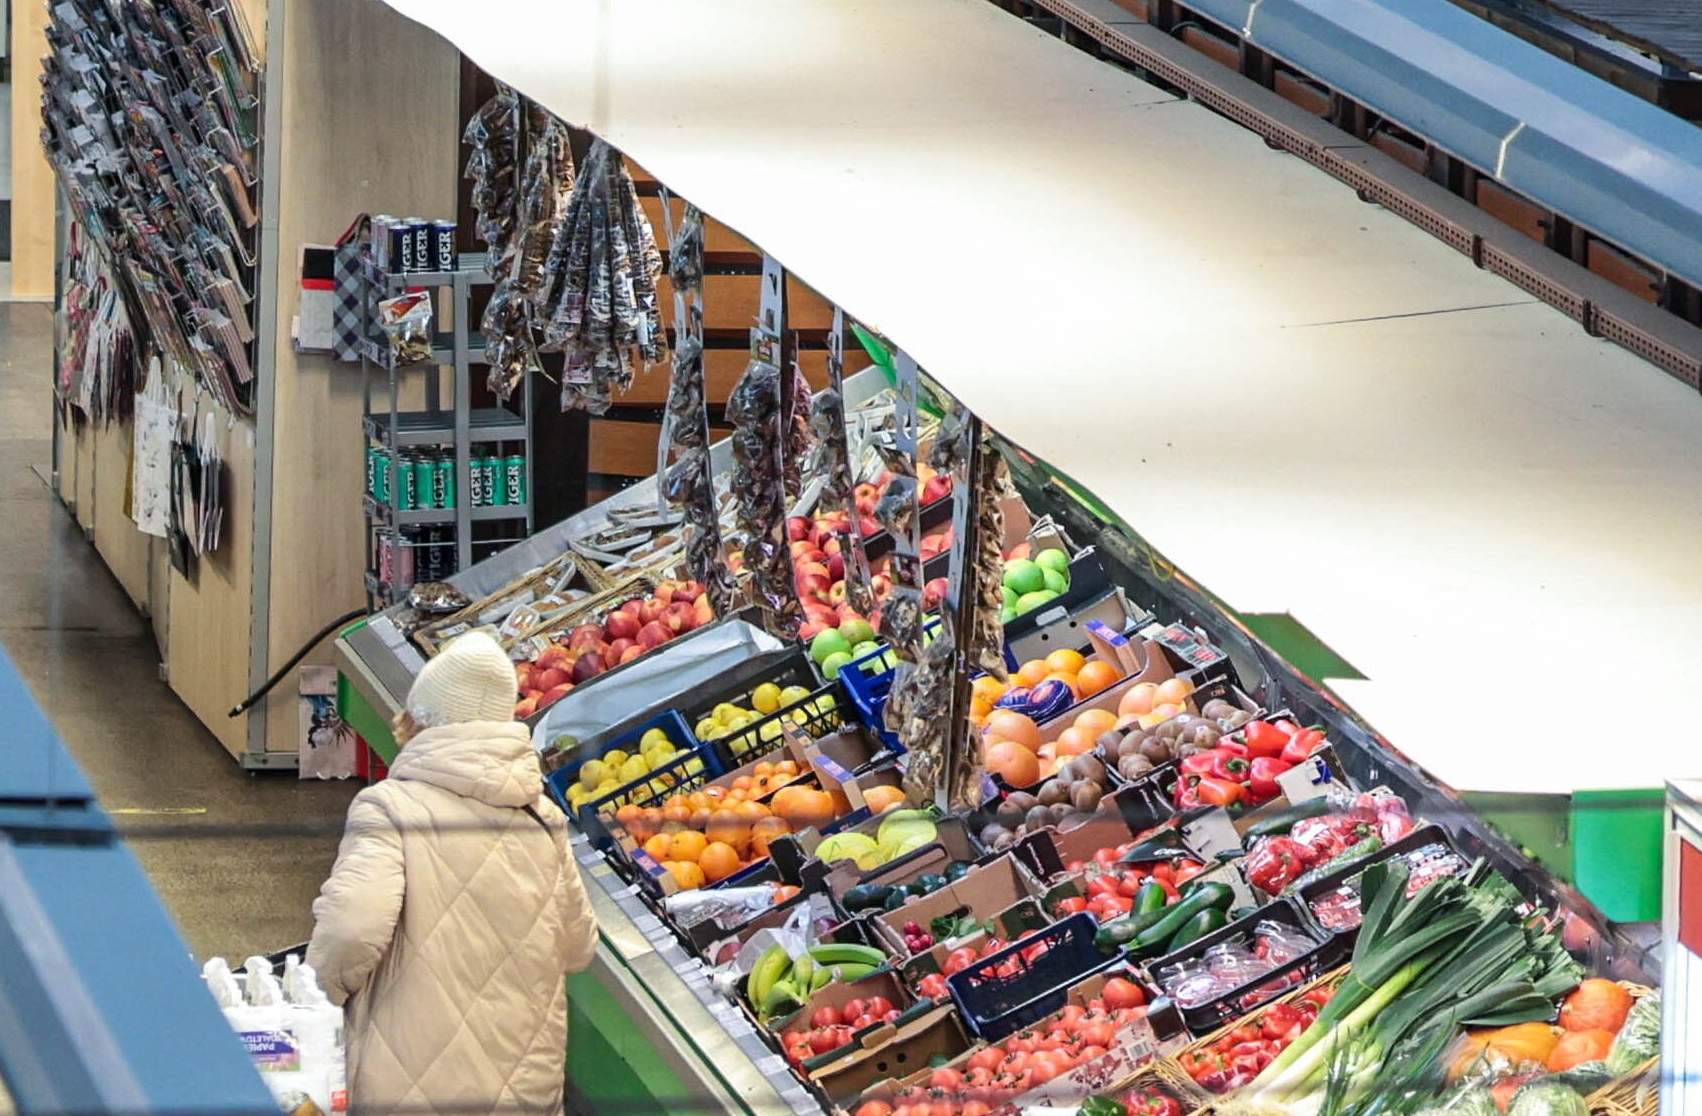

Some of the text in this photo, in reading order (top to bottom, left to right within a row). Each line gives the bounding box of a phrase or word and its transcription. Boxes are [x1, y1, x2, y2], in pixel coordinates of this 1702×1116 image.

[402, 233, 412, 273] IGER
[416, 229, 428, 272] IGER
[439, 231, 451, 273] IGER
[470, 467, 482, 508] IGER
[483, 466, 493, 505] IGER
[507, 464, 520, 505] IGER
